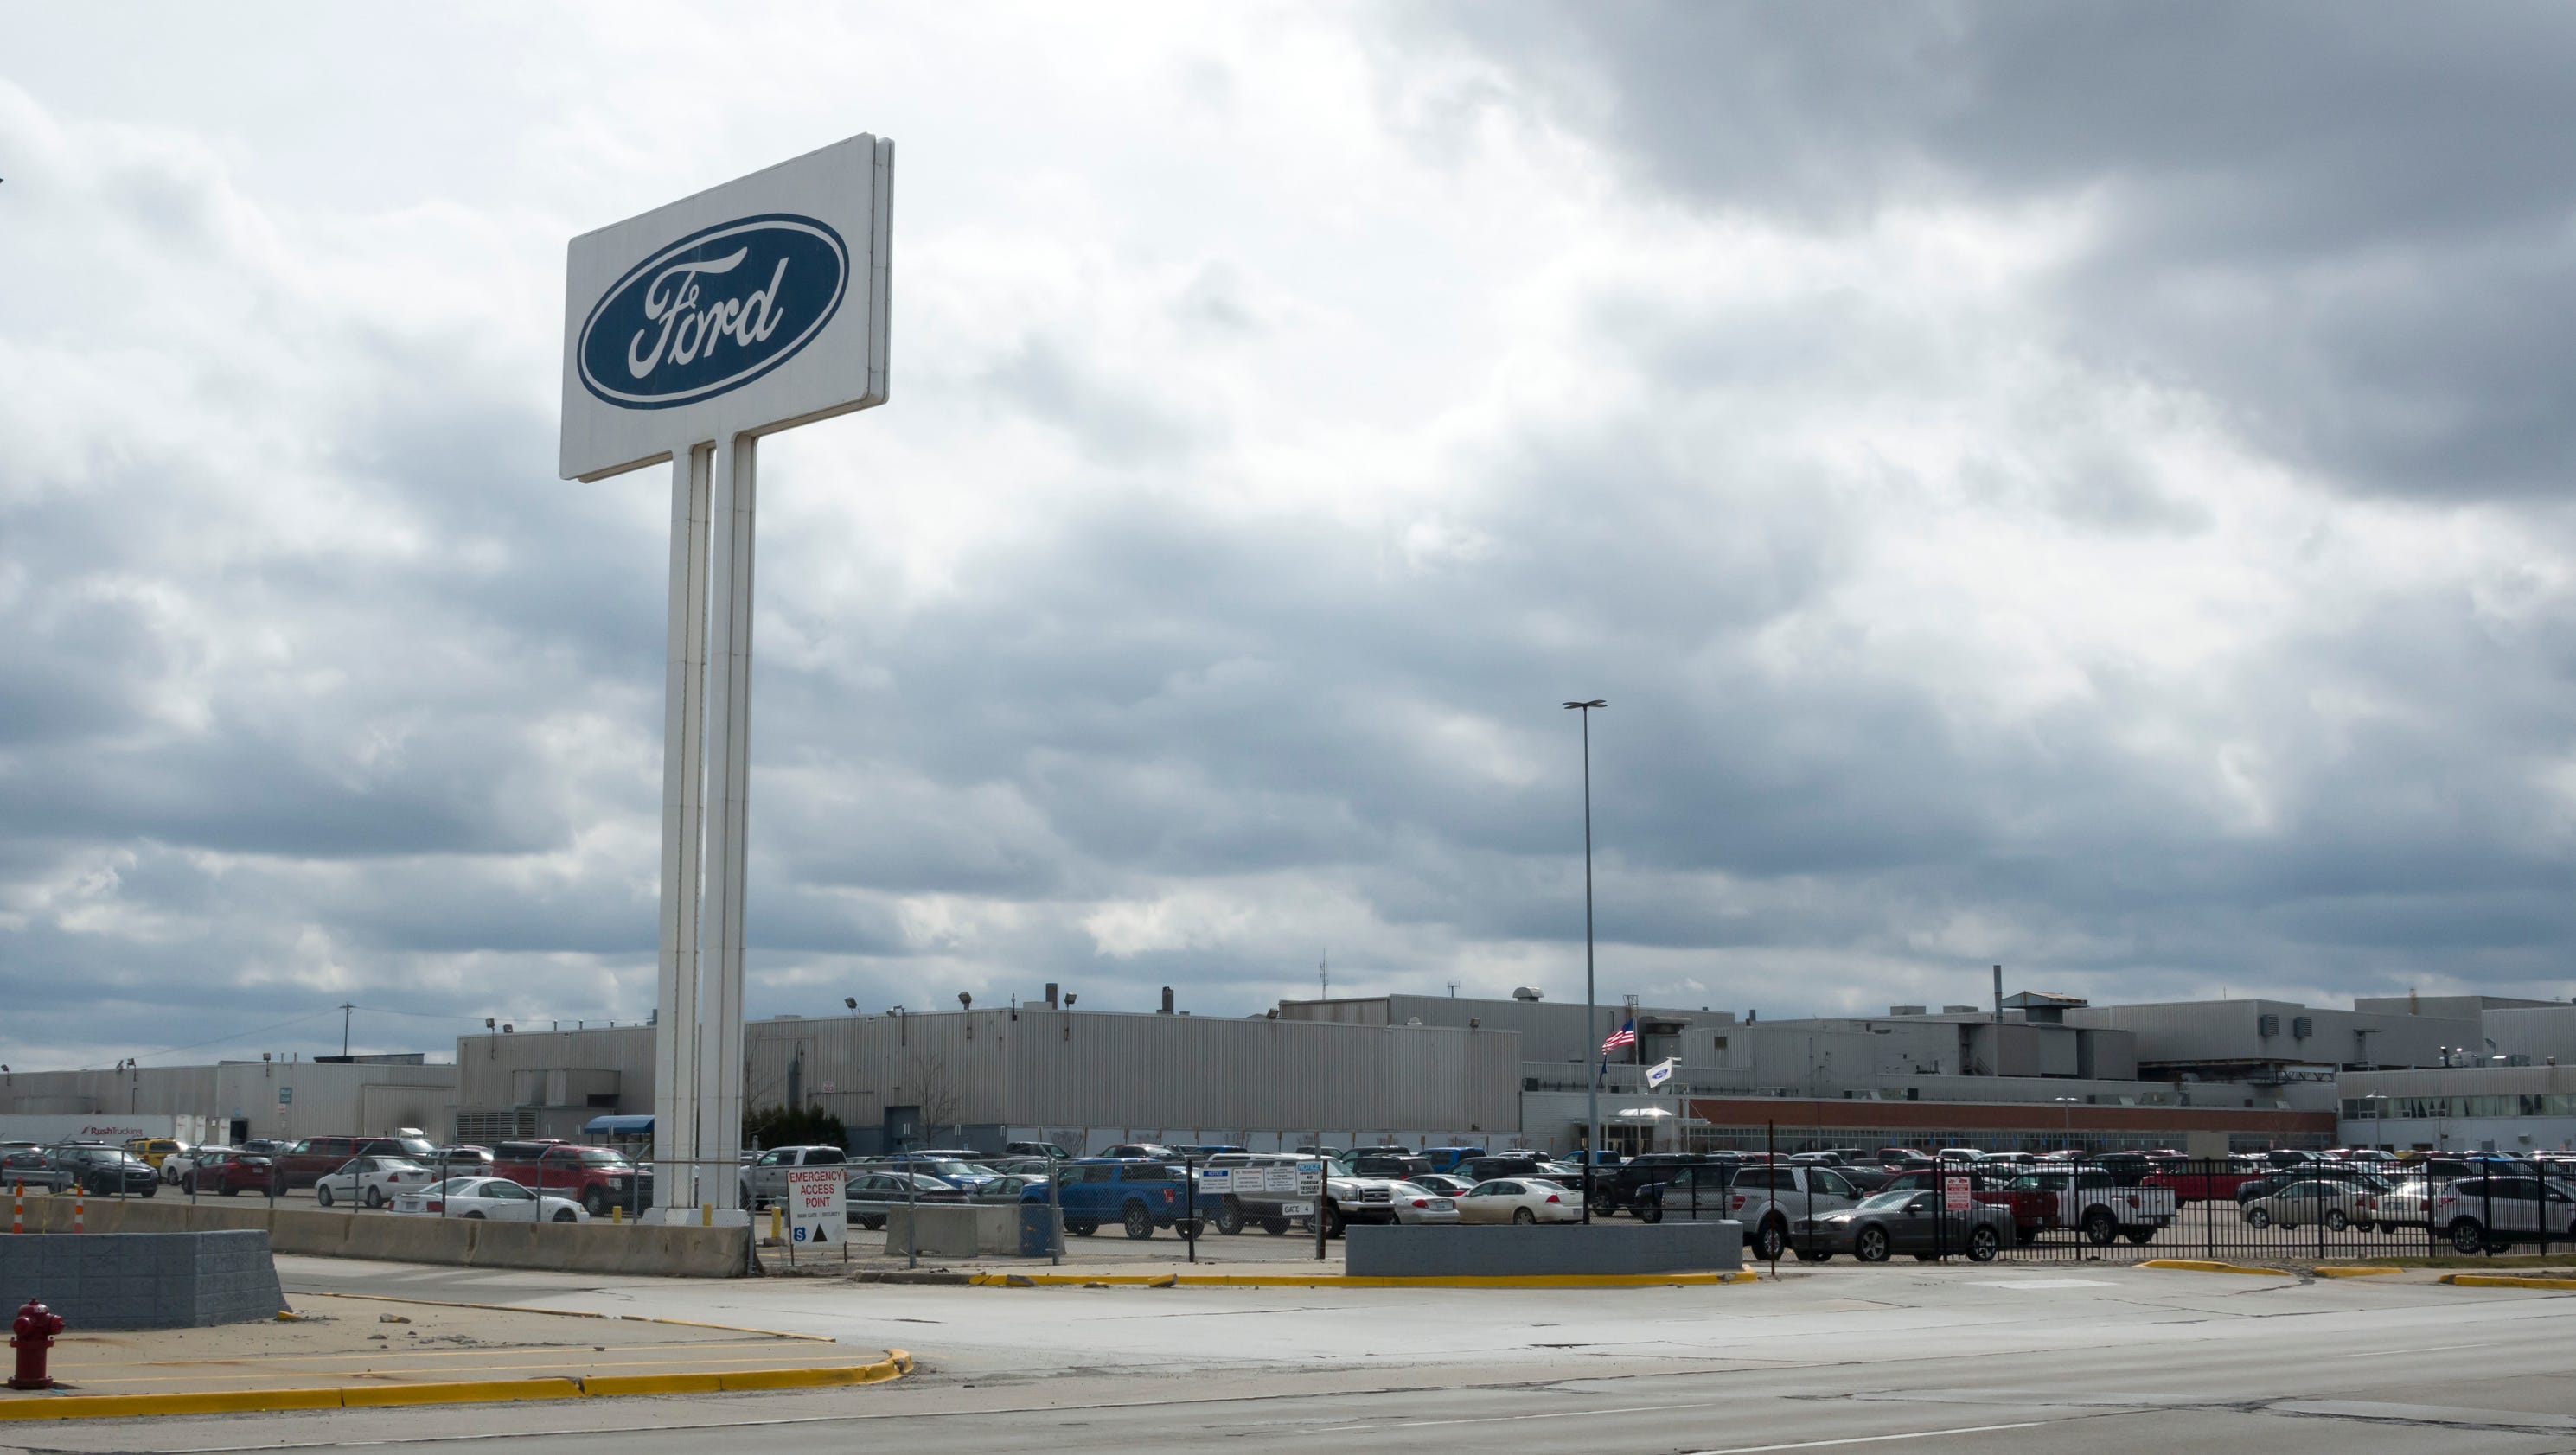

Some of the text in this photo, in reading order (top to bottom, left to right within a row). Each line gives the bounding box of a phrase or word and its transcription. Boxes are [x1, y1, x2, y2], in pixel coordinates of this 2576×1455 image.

[628, 246, 789, 379] Ford
[789, 1171, 842, 1183] EMERGENCY
[801, 1184, 835, 1195] ACCESS
[805, 1197, 830, 1208] POINT
